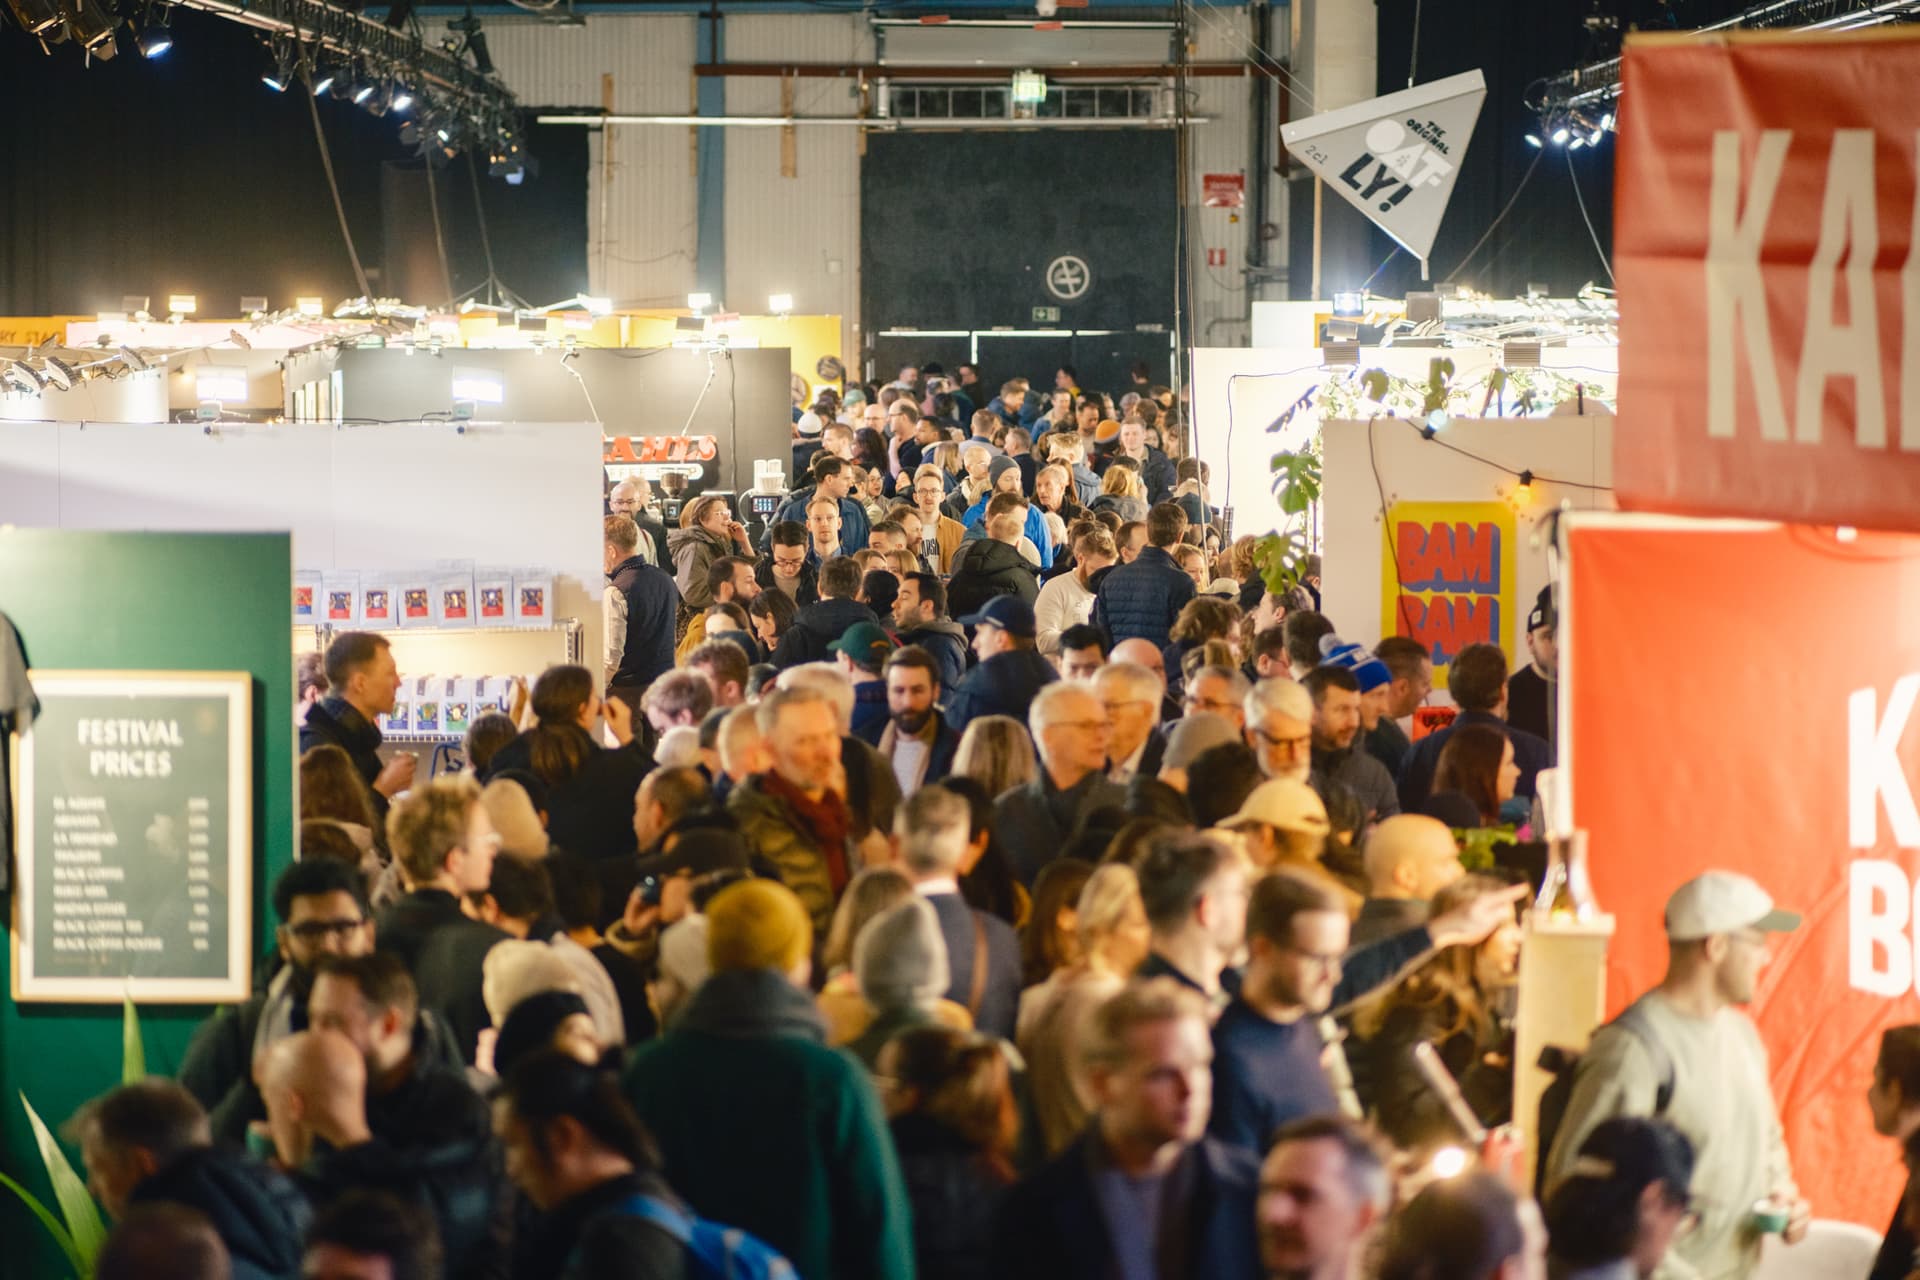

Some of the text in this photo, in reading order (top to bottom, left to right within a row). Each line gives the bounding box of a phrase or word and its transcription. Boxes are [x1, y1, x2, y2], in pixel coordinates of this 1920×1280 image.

[1406, 118, 1449, 155] ORIGINAL
[1426, 120, 1447, 138] THE
[1339, 152, 1414, 212] LY!
[1397, 521, 1500, 594] BAM
[78, 718, 184, 747] FESTIVAL
[89, 750, 172, 778] PRICES
